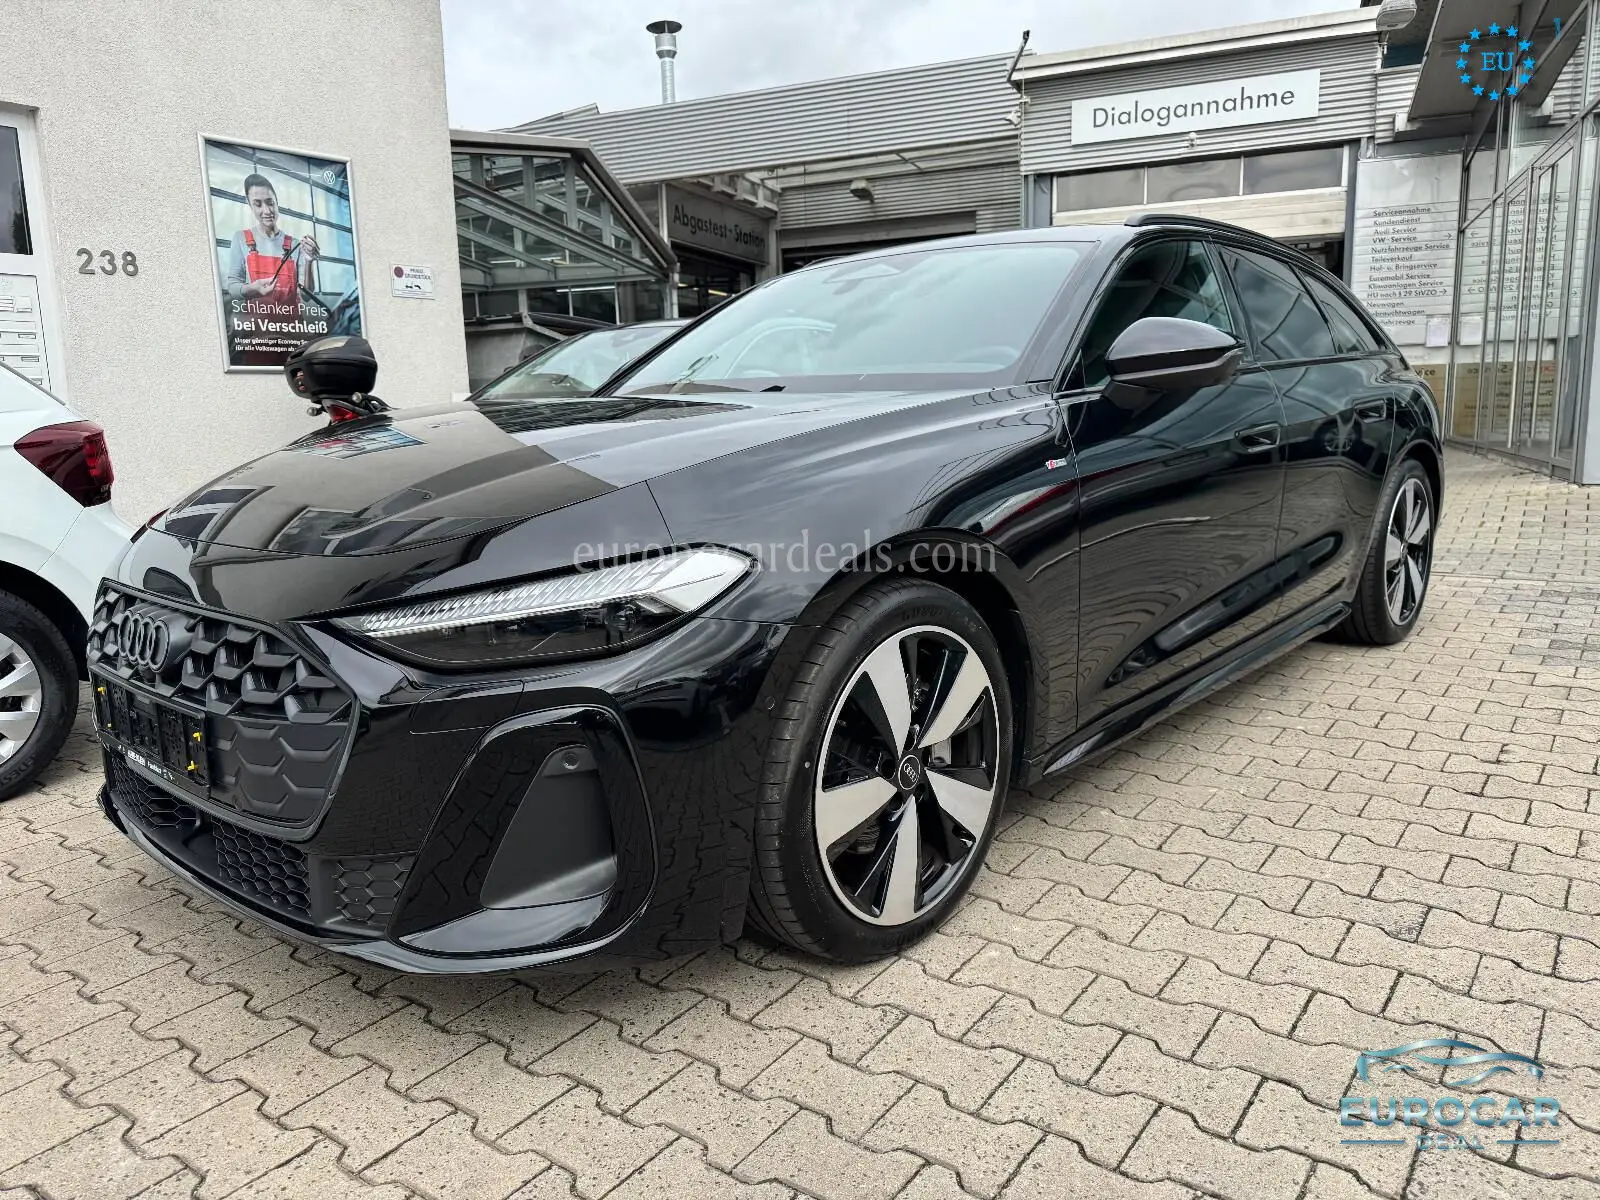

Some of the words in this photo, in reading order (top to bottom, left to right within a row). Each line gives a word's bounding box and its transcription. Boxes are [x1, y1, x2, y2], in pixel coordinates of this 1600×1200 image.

[1093, 86, 1295, 128] Dialogannahme
[1373, 207, 1431, 217] Serviceannahme
[673, 204, 765, 249] Abgastest-Station
[1373, 217, 1421, 226] Kundendienst
[76, 247, 139, 276] 238
[1369, 273, 1404, 282] Euromobil
[231, 299, 297, 315] Schlanker
[298, 303, 328, 317] Preis
[1366, 301, 1405, 309] Neuwagen
[233, 317, 256, 331] bei
[257, 318, 328, 334] Verschleiß
[251, 337, 277, 345] günstiger
[255, 345, 287, 353] Volkswagen
